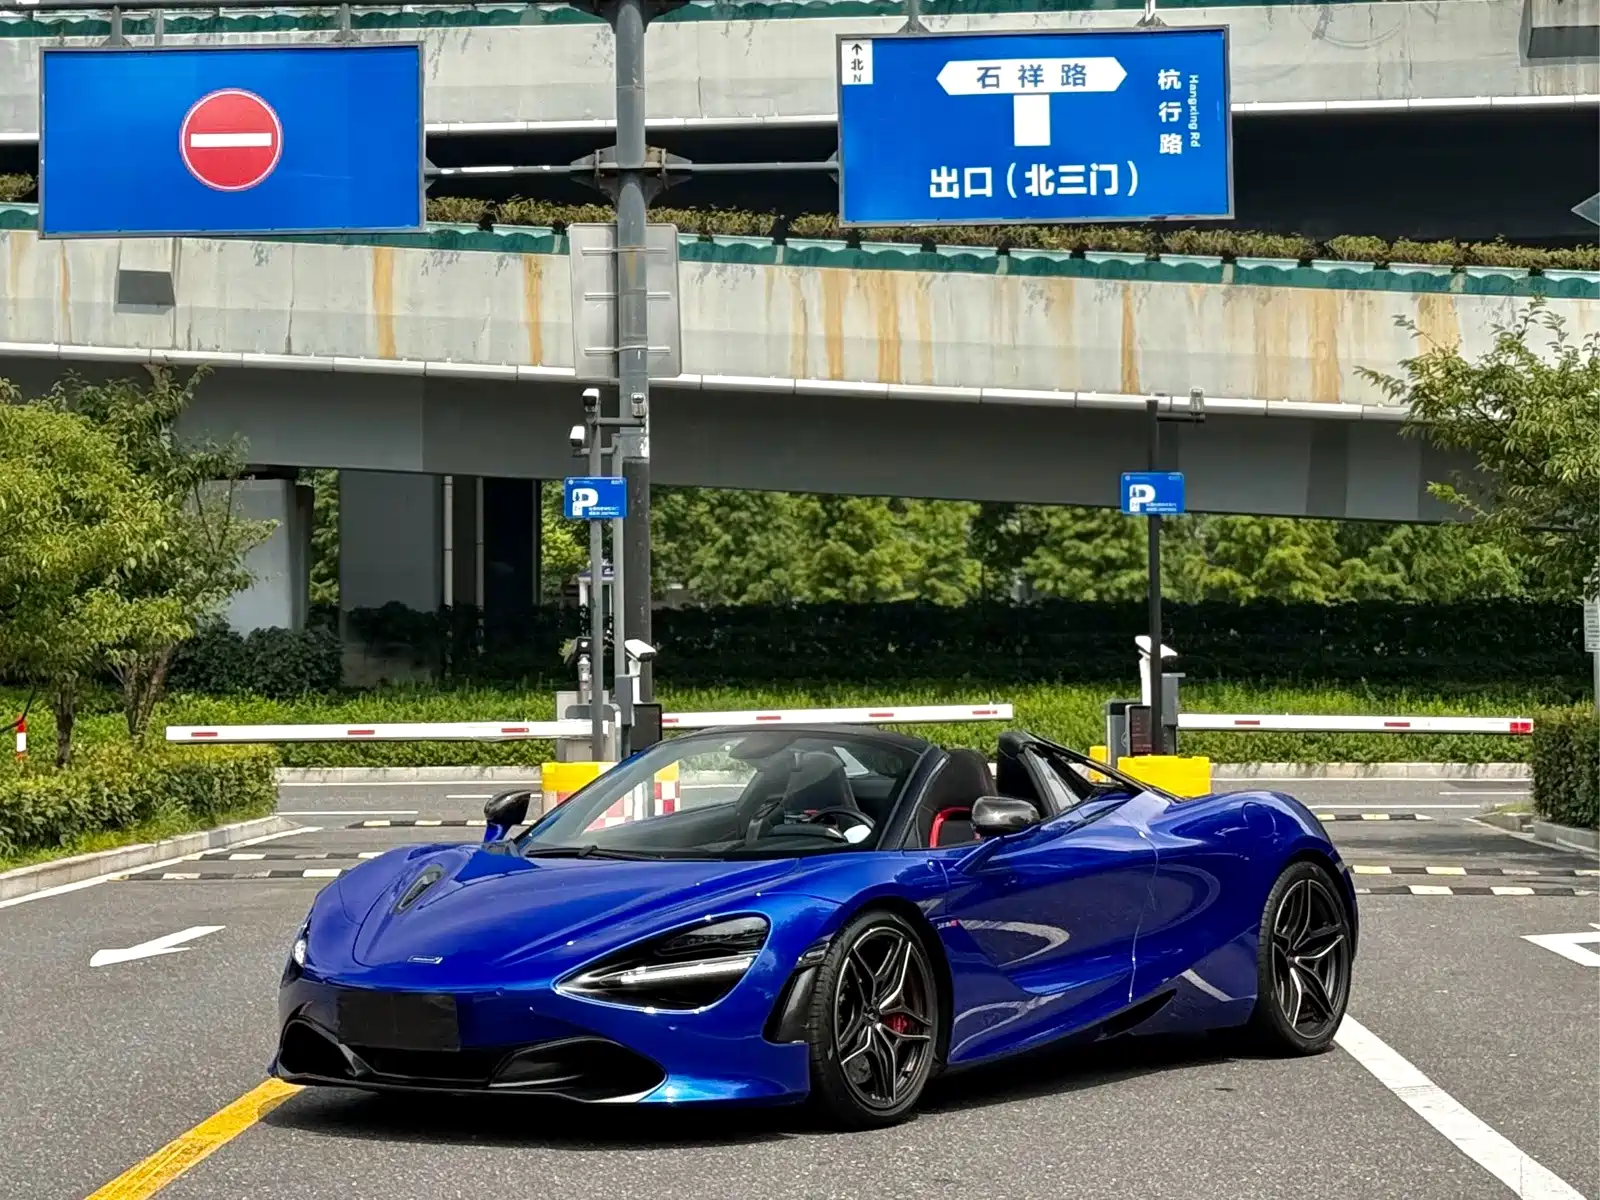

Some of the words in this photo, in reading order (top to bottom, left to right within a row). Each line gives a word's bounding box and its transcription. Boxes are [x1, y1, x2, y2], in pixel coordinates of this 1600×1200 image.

[850, 58, 864, 71] 北
[853, 74, 862, 83] N
[976, 63, 1087, 89] 石祥路
[1157, 68, 1183, 155] 杭行路
[1187, 74, 1200, 130] Hangxing
[1190, 131, 1201, 147] Rd
[929, 160, 1138, 199] 出口（北三门）
[572, 488, 598, 516] P
[1129, 484, 1155, 512] P
